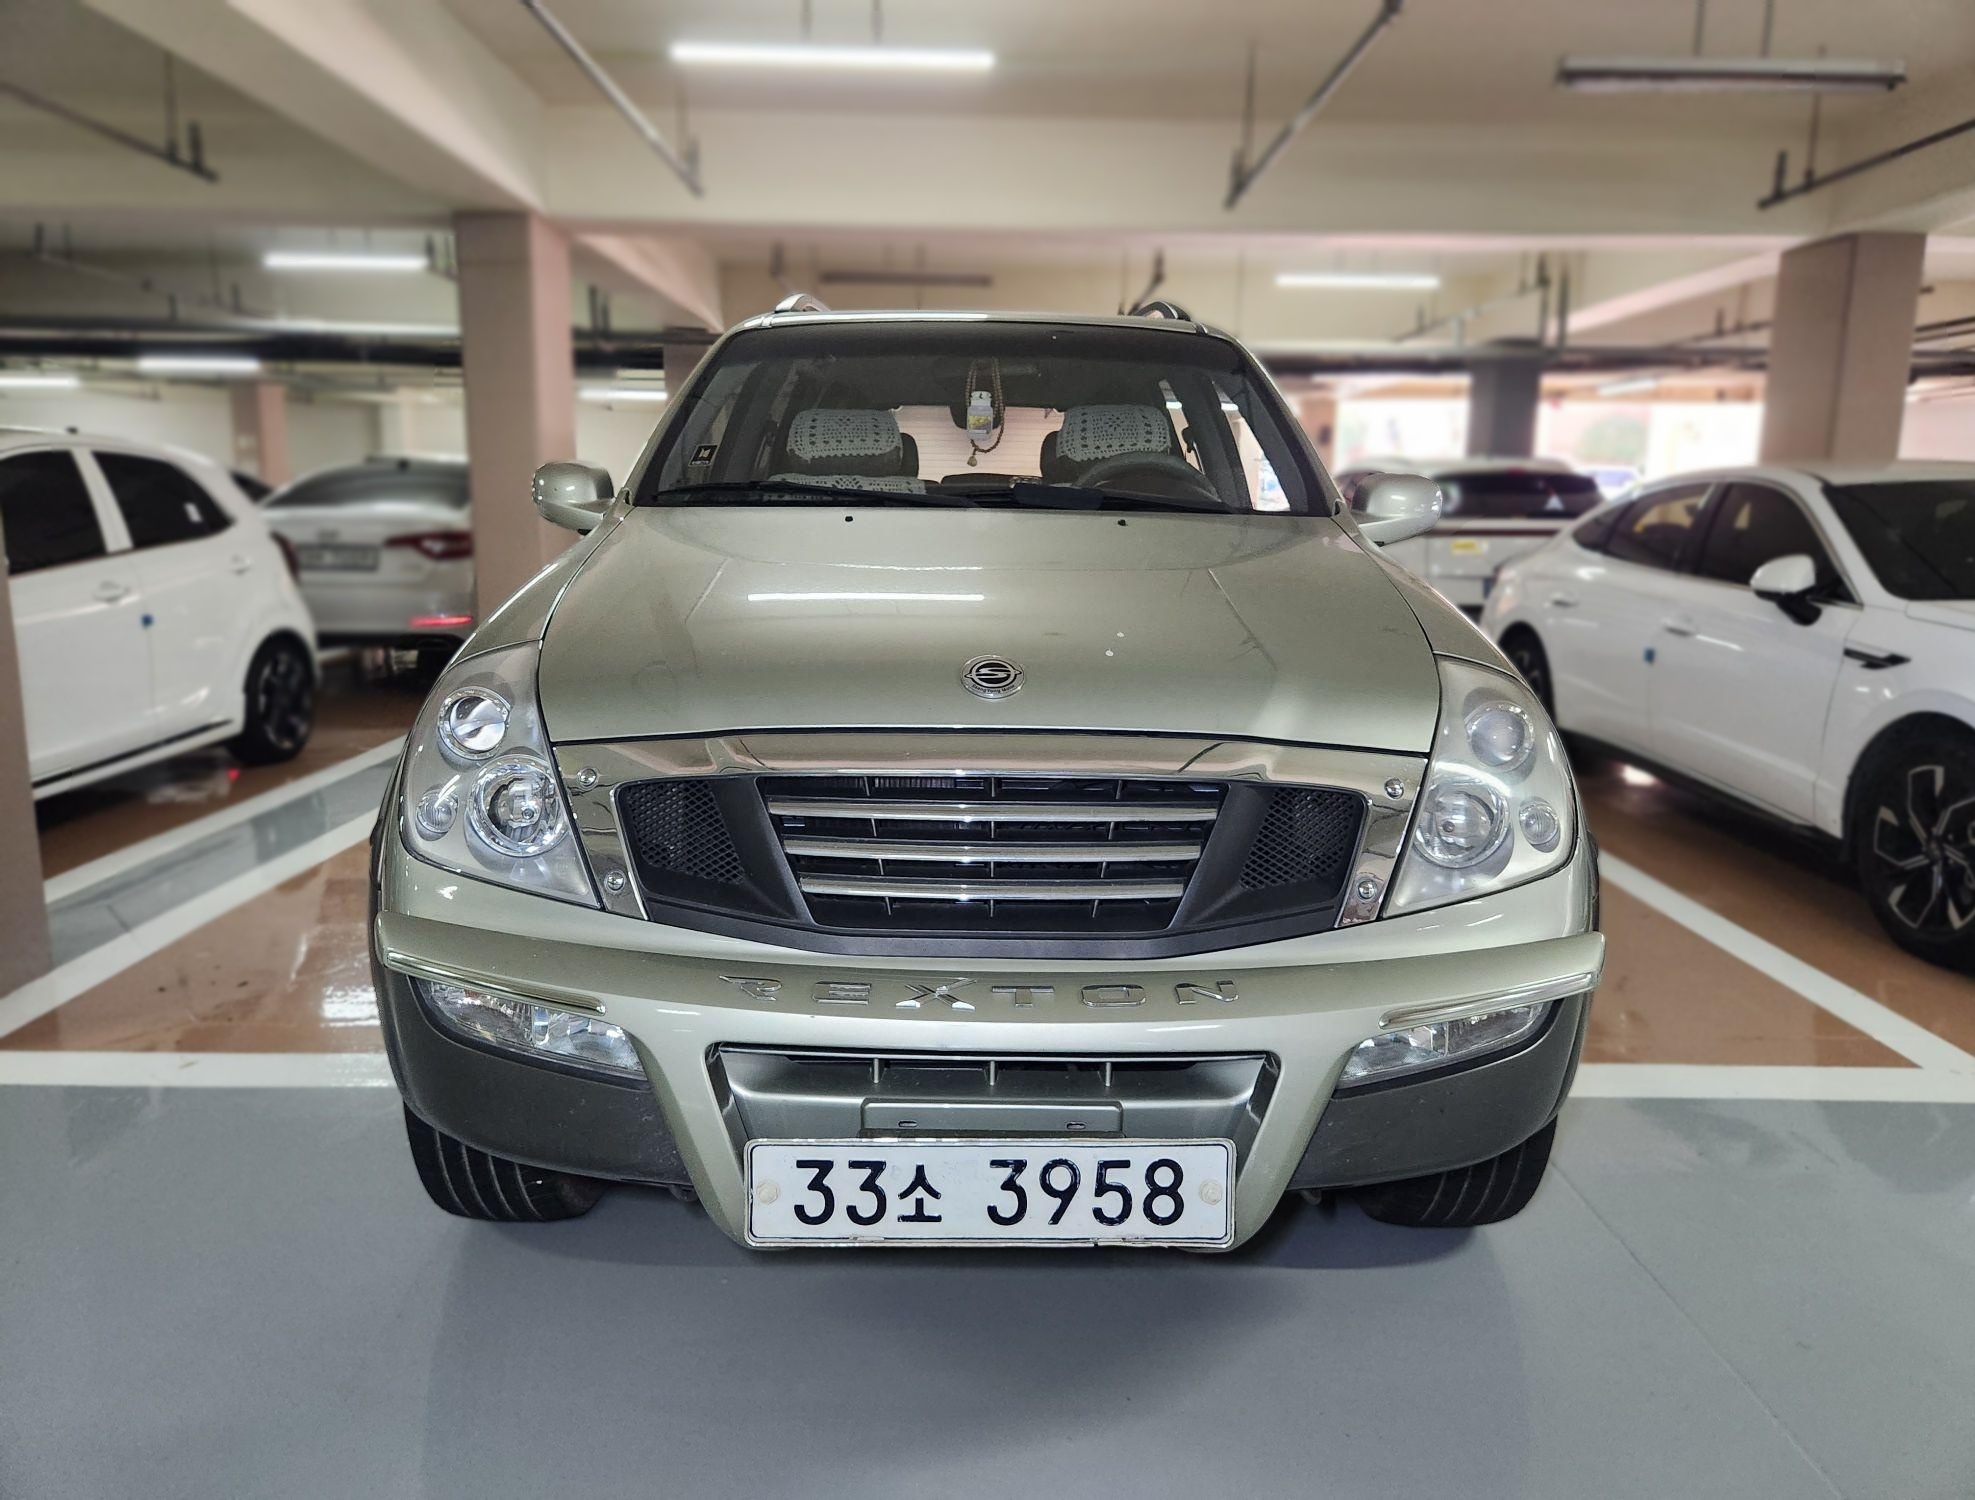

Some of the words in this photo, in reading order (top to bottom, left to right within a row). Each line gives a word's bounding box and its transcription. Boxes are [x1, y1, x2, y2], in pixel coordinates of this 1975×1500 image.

[718, 974, 1240, 1009] REXTON
[793, 1159, 942, 1226] 33소
[987, 1158, 1185, 1226] 3958
